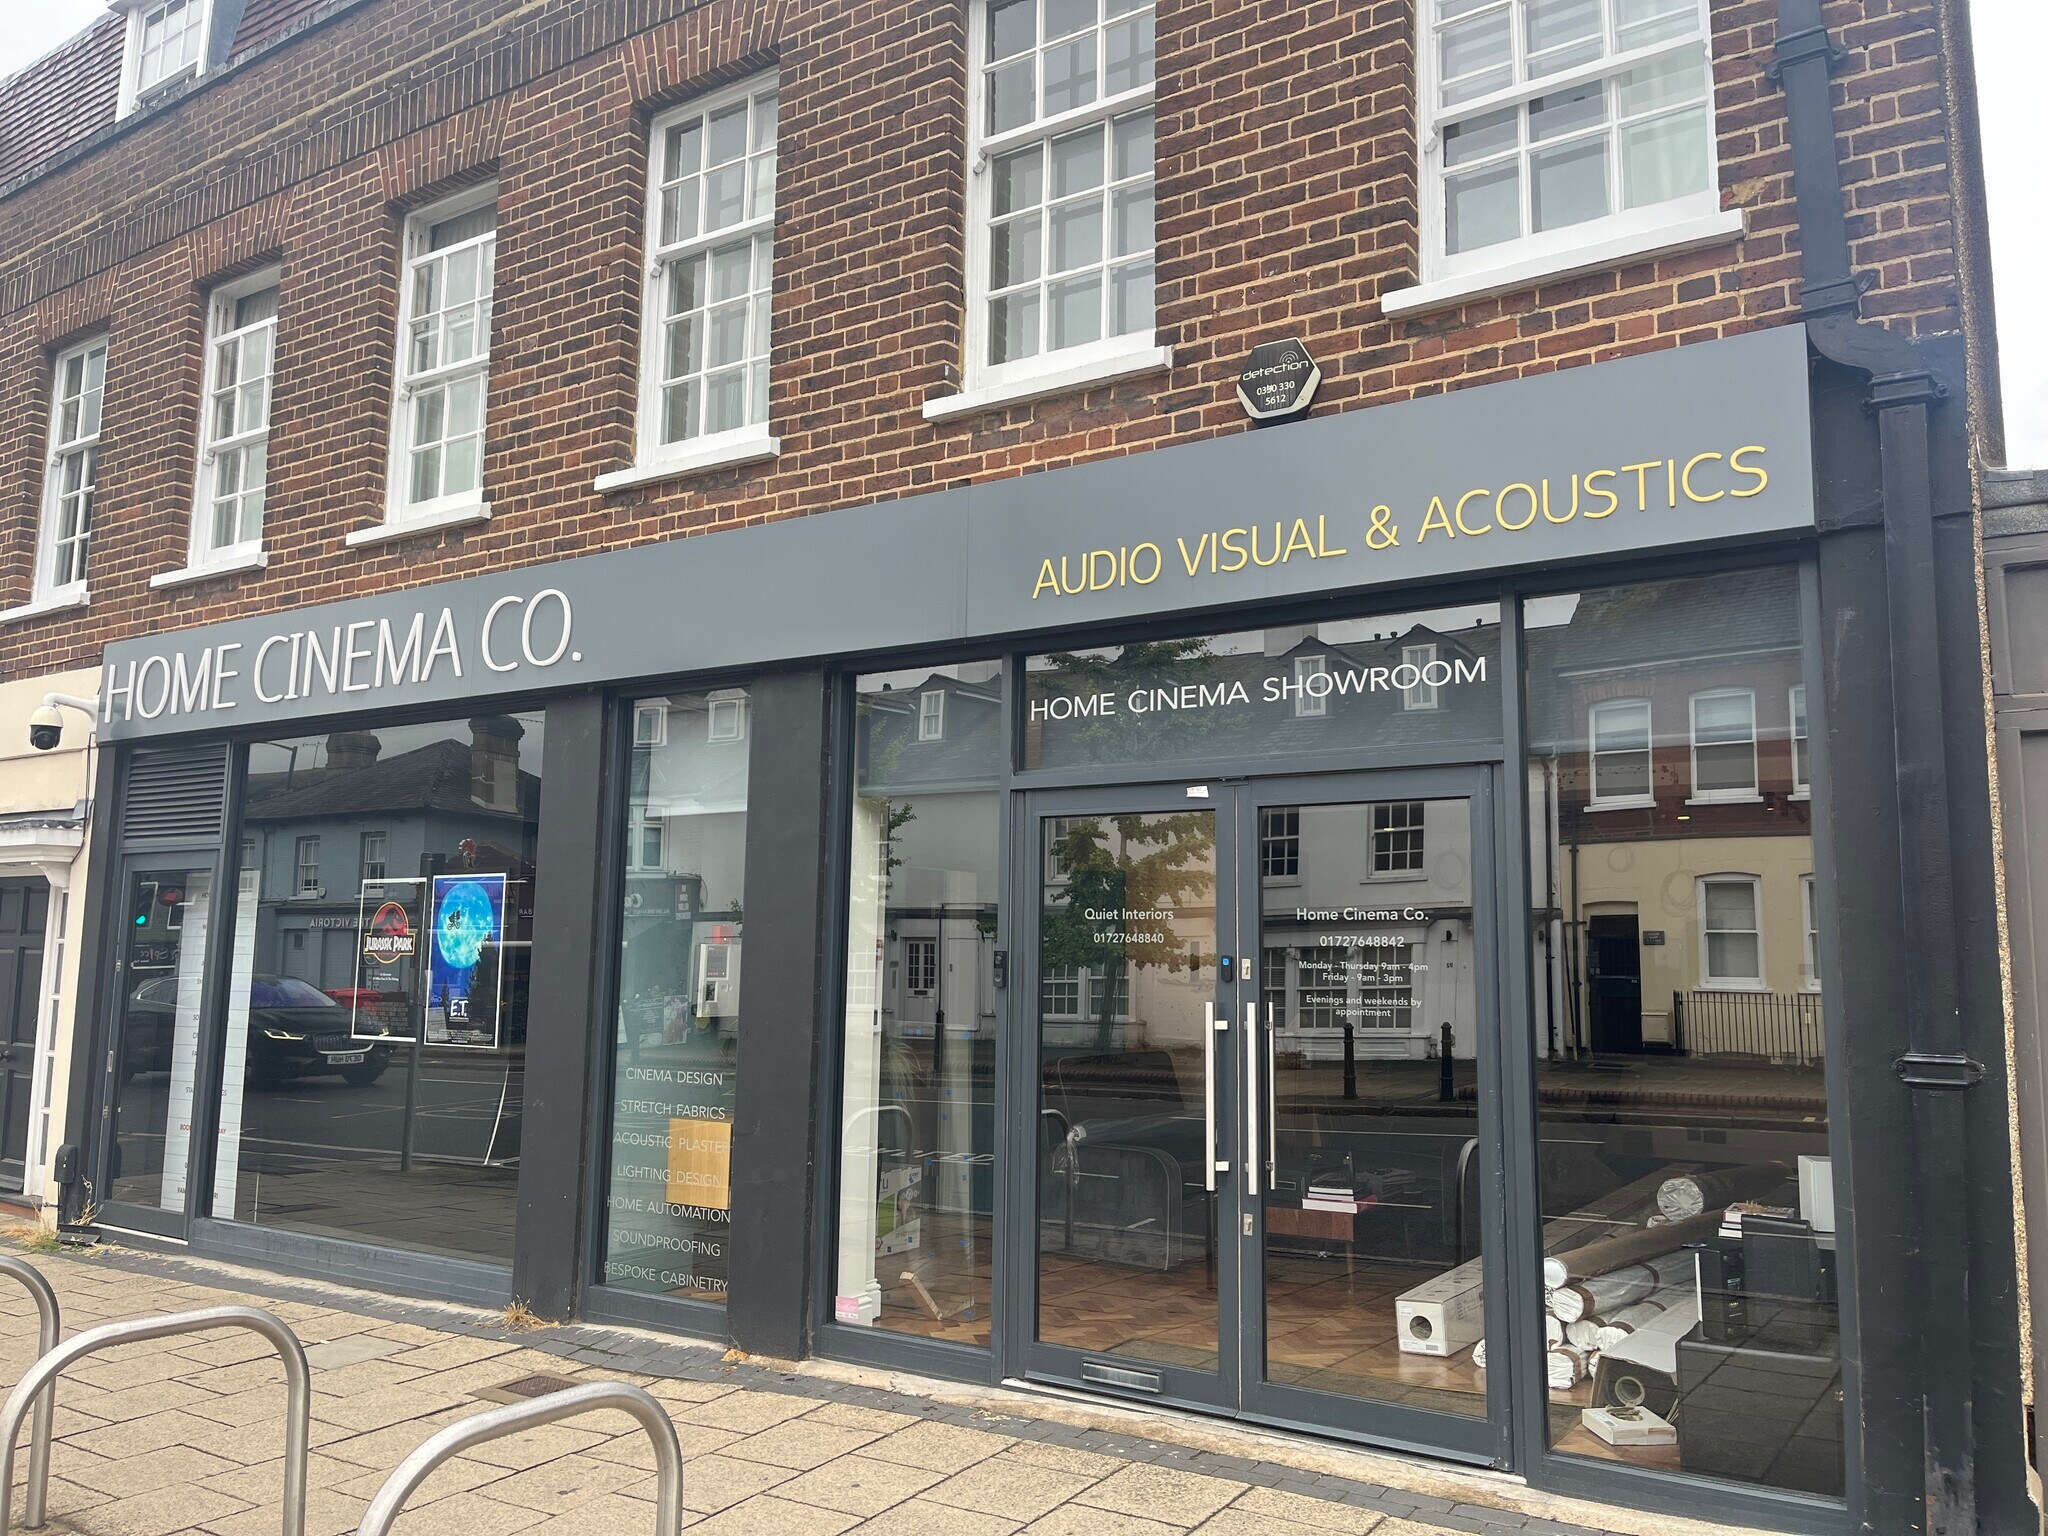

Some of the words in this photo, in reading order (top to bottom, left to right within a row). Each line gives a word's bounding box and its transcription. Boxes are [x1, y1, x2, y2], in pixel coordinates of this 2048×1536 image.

[1242, 361, 1308, 381] detection
[1279, 380, 1295, 391] 330
[1265, 394, 1287, 406] 5612
[1033, 542, 1162, 600] AUDIO
[1177, 513, 1347, 577] VISUAL
[1364, 504, 1400, 550] &
[1417, 445, 1769, 544] ACOUSTICS
[104, 642, 243, 724] HOME
[254, 607, 463, 703] CINEMA
[481, 588, 583, 673] CO.
[1029, 692, 1116, 721] HOME
[1128, 680, 1250, 714] CINEMA
[1262, 656, 1487, 703] SHOWROOM
[1084, 908, 1118, 920] Quiet
[1122, 907, 1174, 920] Interiors
[1296, 907, 1338, 921] Home
[1343, 907, 1398, 921] Cinema
[1403, 907, 1429, 921] Co.
[364, 935, 393, 952] JURASSIC
[392, 935, 413, 952] PARK
[1093, 933, 1164, 943] 01727648840
[1319, 936, 1405, 948] 01727648842
[1299, 961, 1332, 971] Monday
[1340, 961, 1379, 972] Thursday
[1381, 963, 1400, 971] 9am
[1408, 963, 1429, 973] 4pm
[1322, 973, 1349, 983] Friday
[1356, 973, 1375, 982] 9am
[1383, 974, 1403, 984] 3pm
[450, 999, 469, 1017] E.T.
[1306, 995, 1344, 1006] Evenings
[1345, 996, 1362, 1004] and
[1364, 996, 1408, 1006] weekends
[1410, 998, 1422, 1008] by
[1335, 1008, 1391, 1017] appointment
[626, 1067, 673, 1082] CINEMA
[677, 1070, 723, 1086] DESIGN
[620, 1099, 672, 1115] STRETCH
[676, 1104, 726, 1120] FABRICS
[613, 1131, 673, 1149] ACOUSTIC
[617, 1164, 671, 1182] LIGHTING
[676, 1171, 722, 1186] DESIGN
[606, 1195, 643, 1212] HOME
[647, 1201, 731, 1223] AUTOMATION
[613, 1229, 721, 1257] SOUNDPROOFING
[604, 1261, 656, 1283] BESPOKE
[660, 1270, 729, 1292] CABINETRY
